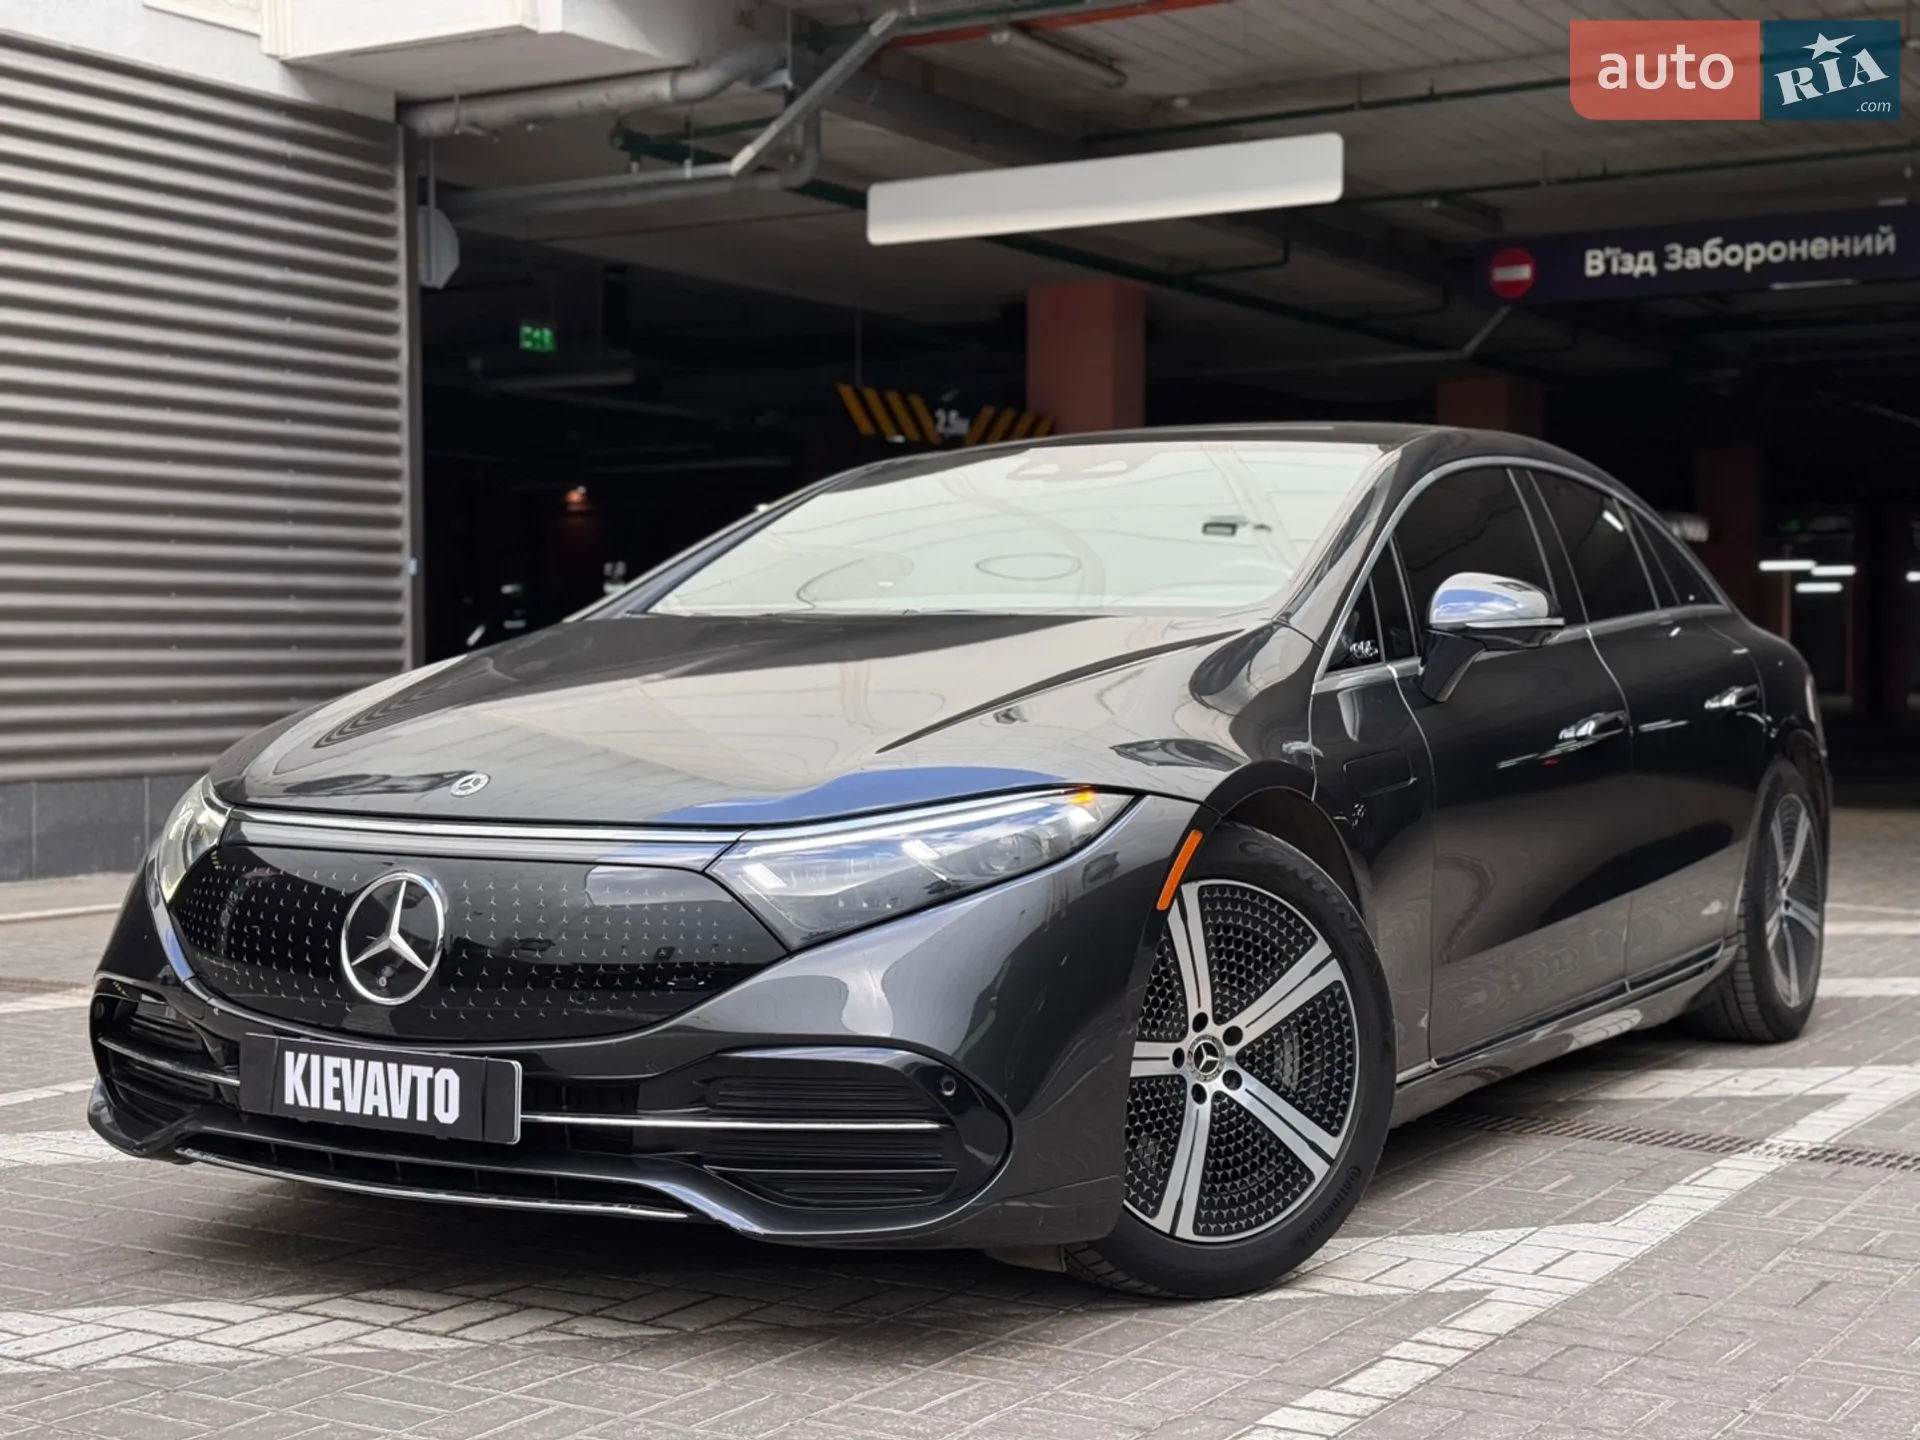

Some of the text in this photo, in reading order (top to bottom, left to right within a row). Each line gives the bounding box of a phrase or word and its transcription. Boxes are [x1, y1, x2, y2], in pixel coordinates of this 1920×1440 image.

[1584, 225, 1897, 279] В'їзд Заборонений
[284, 1050, 460, 1125] KIEVAVTO
